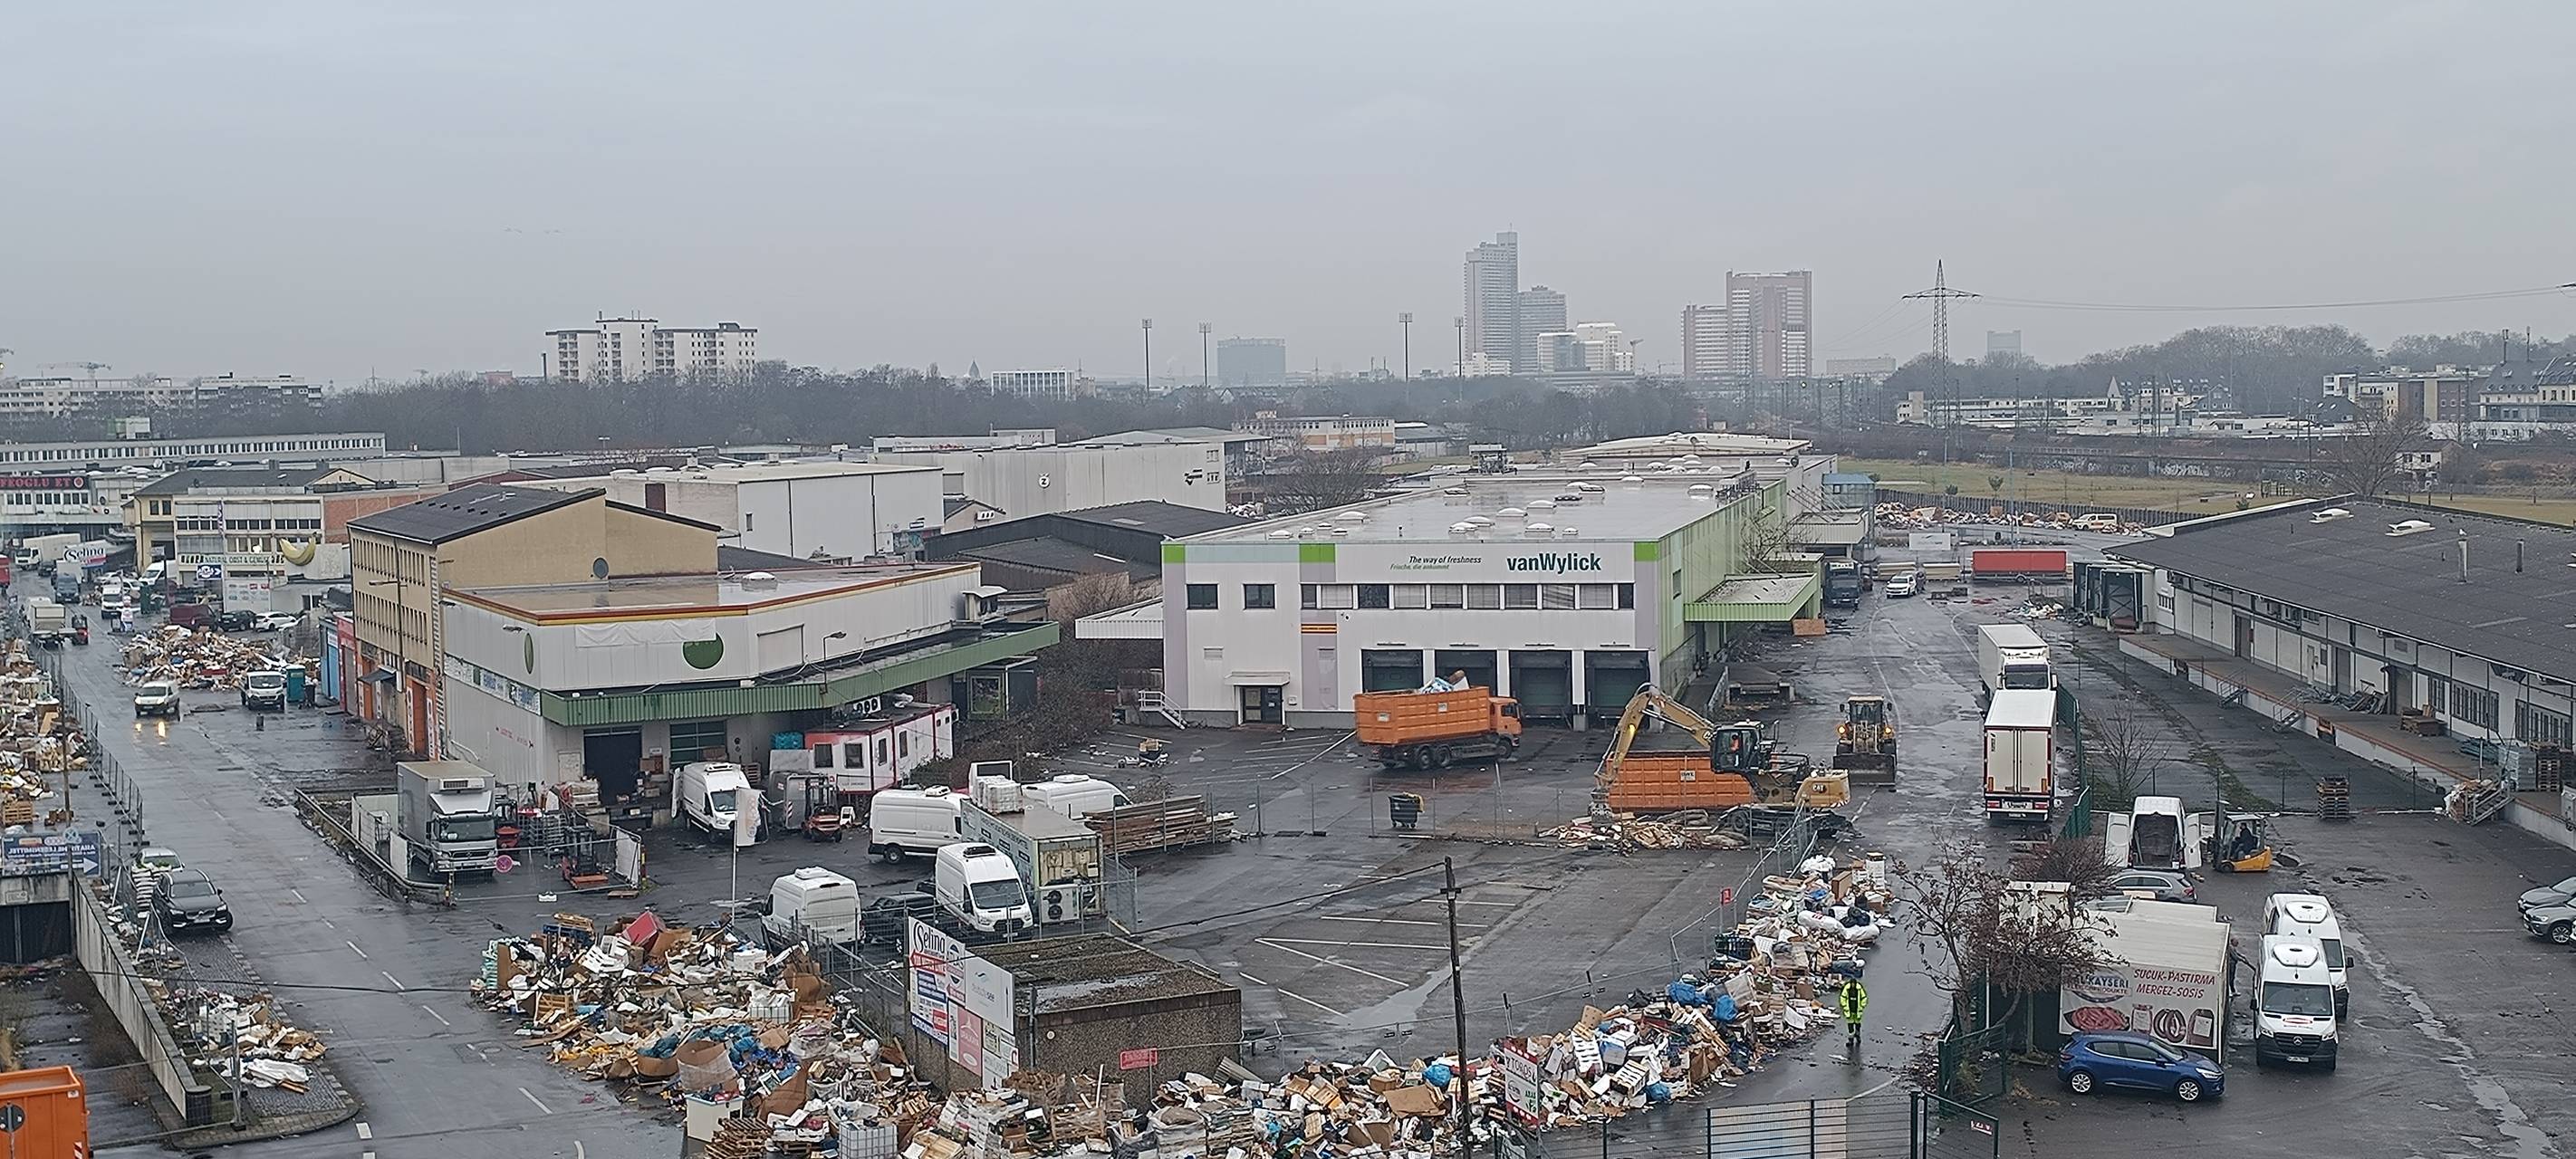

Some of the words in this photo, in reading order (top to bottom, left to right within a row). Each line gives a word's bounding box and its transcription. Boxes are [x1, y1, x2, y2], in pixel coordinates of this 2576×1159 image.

[1408, 556, 1423, 564] The
[1438, 556, 1447, 564] of
[1447, 556, 1482, 564] freshness
[1506, 552, 1601, 574] vanWylick
[1812, 784, 1824, 792] CAT
[913, 921, 946, 953] Selina
[2088, 975, 2129, 989] KAYSERI
[2133, 968, 2216, 985] SUCUK-PASTIRMA
